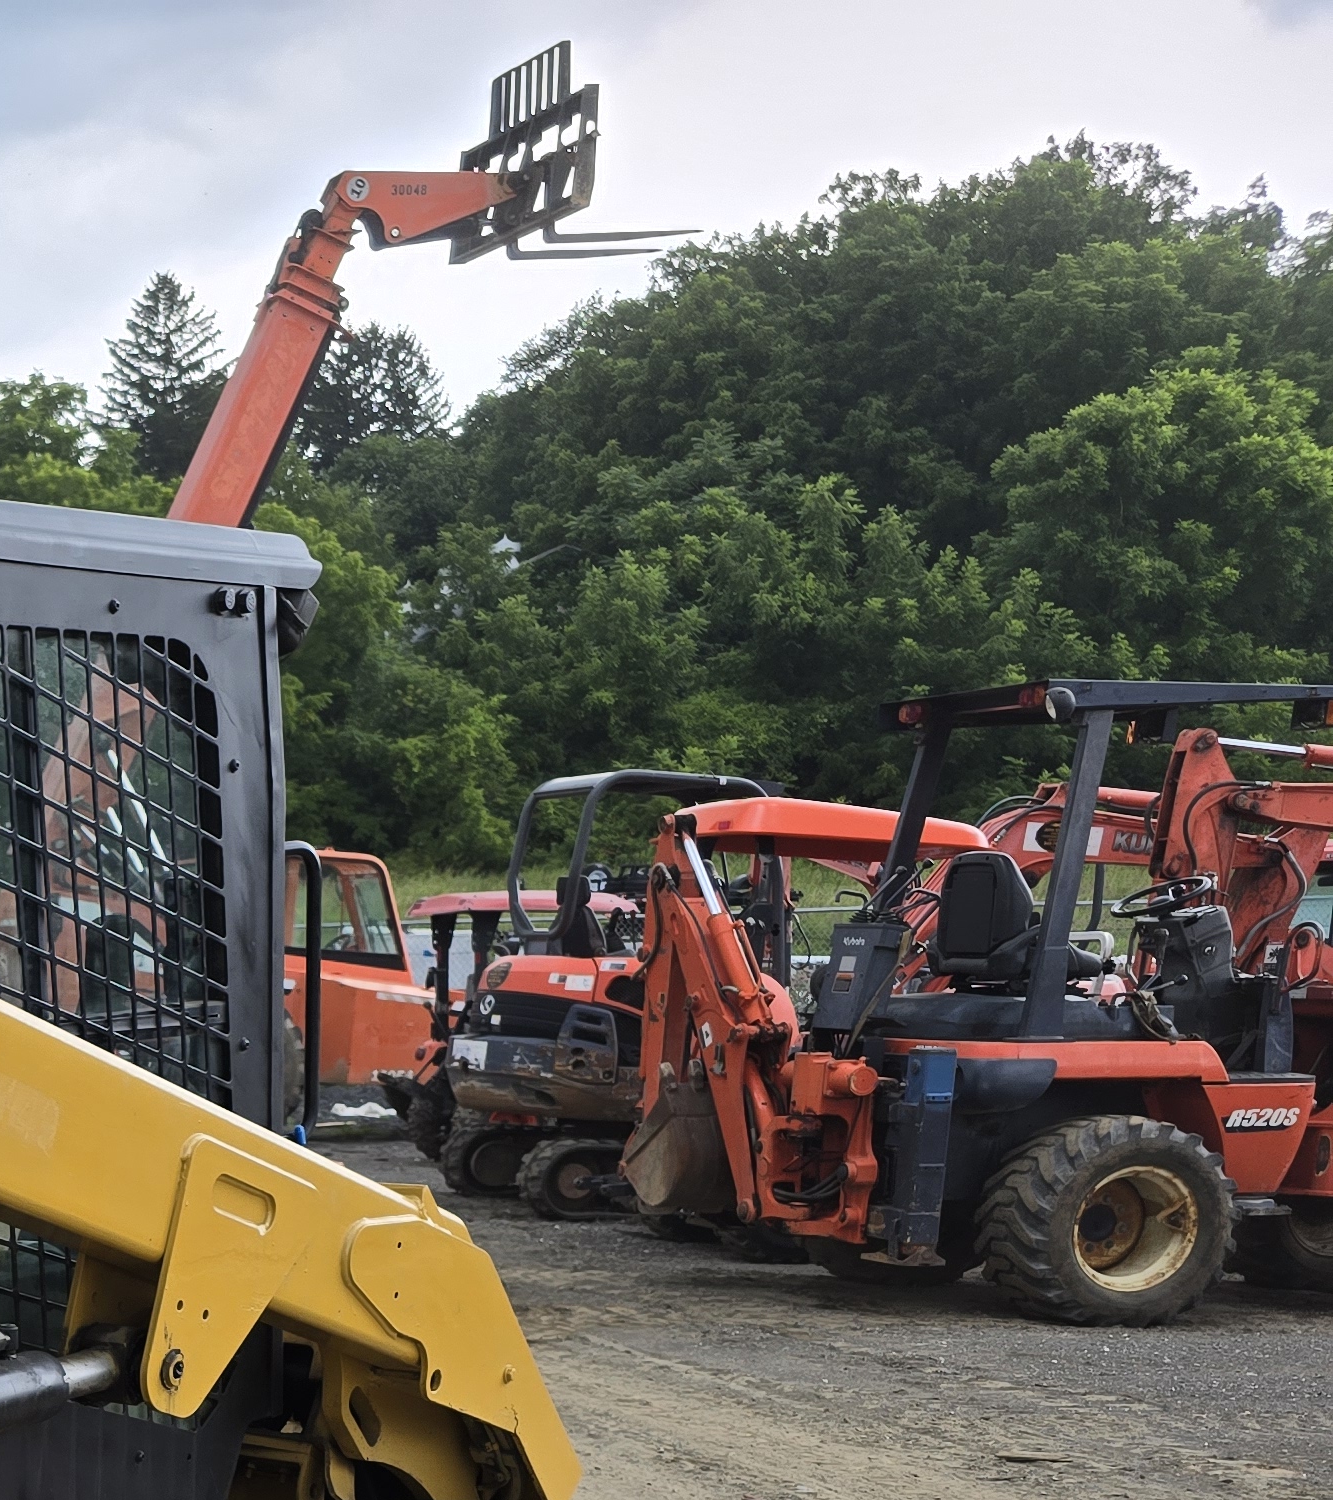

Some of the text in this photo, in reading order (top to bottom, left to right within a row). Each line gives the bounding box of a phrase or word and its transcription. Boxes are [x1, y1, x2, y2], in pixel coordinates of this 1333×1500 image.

[351, 178, 366, 199] 10
[391, 184, 428, 196] 30048
[1225, 1107, 1300, 1128] R520S
